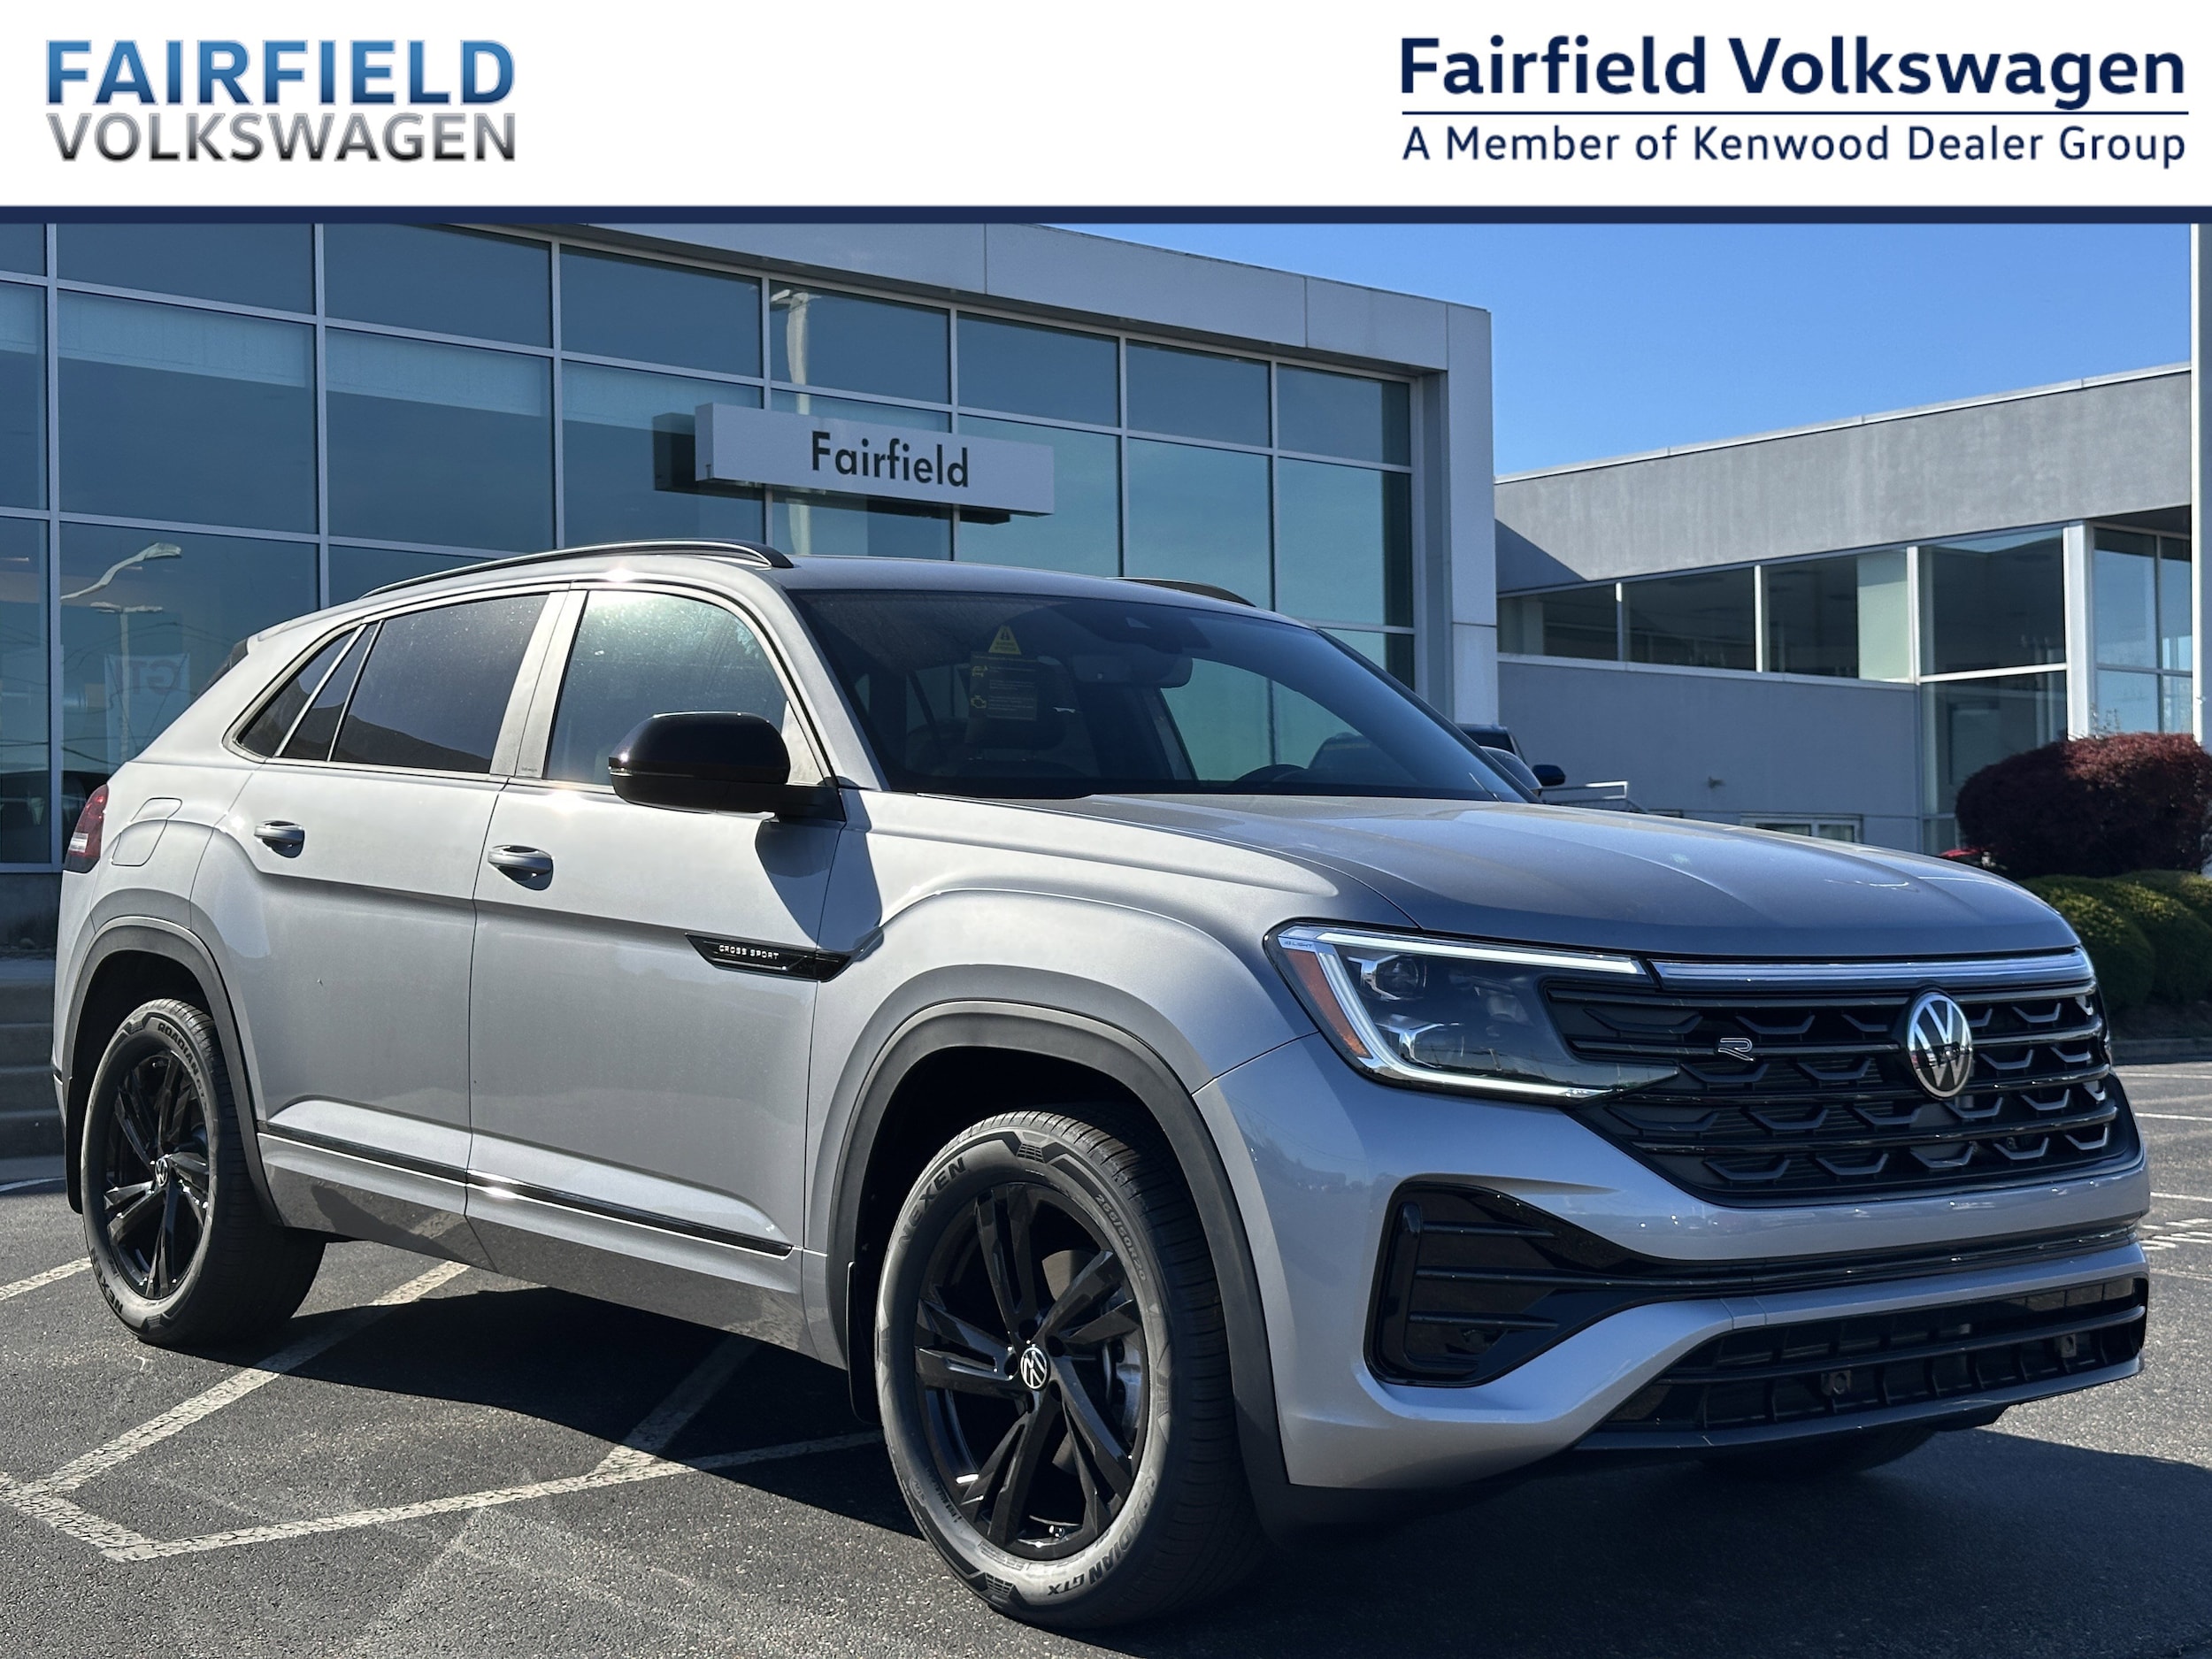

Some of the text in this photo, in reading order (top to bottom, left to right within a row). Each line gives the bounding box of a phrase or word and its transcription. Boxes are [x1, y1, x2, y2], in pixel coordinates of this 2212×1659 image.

[811, 431, 969, 488] Fairfield
[719, 944, 779, 960] CROSS SPORT
[157, 1023, 199, 1076] ROADIAN
[898, 1156, 966, 1249] NEXEN
[90, 1247, 123, 1314] NEXEN
[1088, 1468, 1157, 1585] ROADIAN
[1048, 1573, 1085, 1595] GTX
